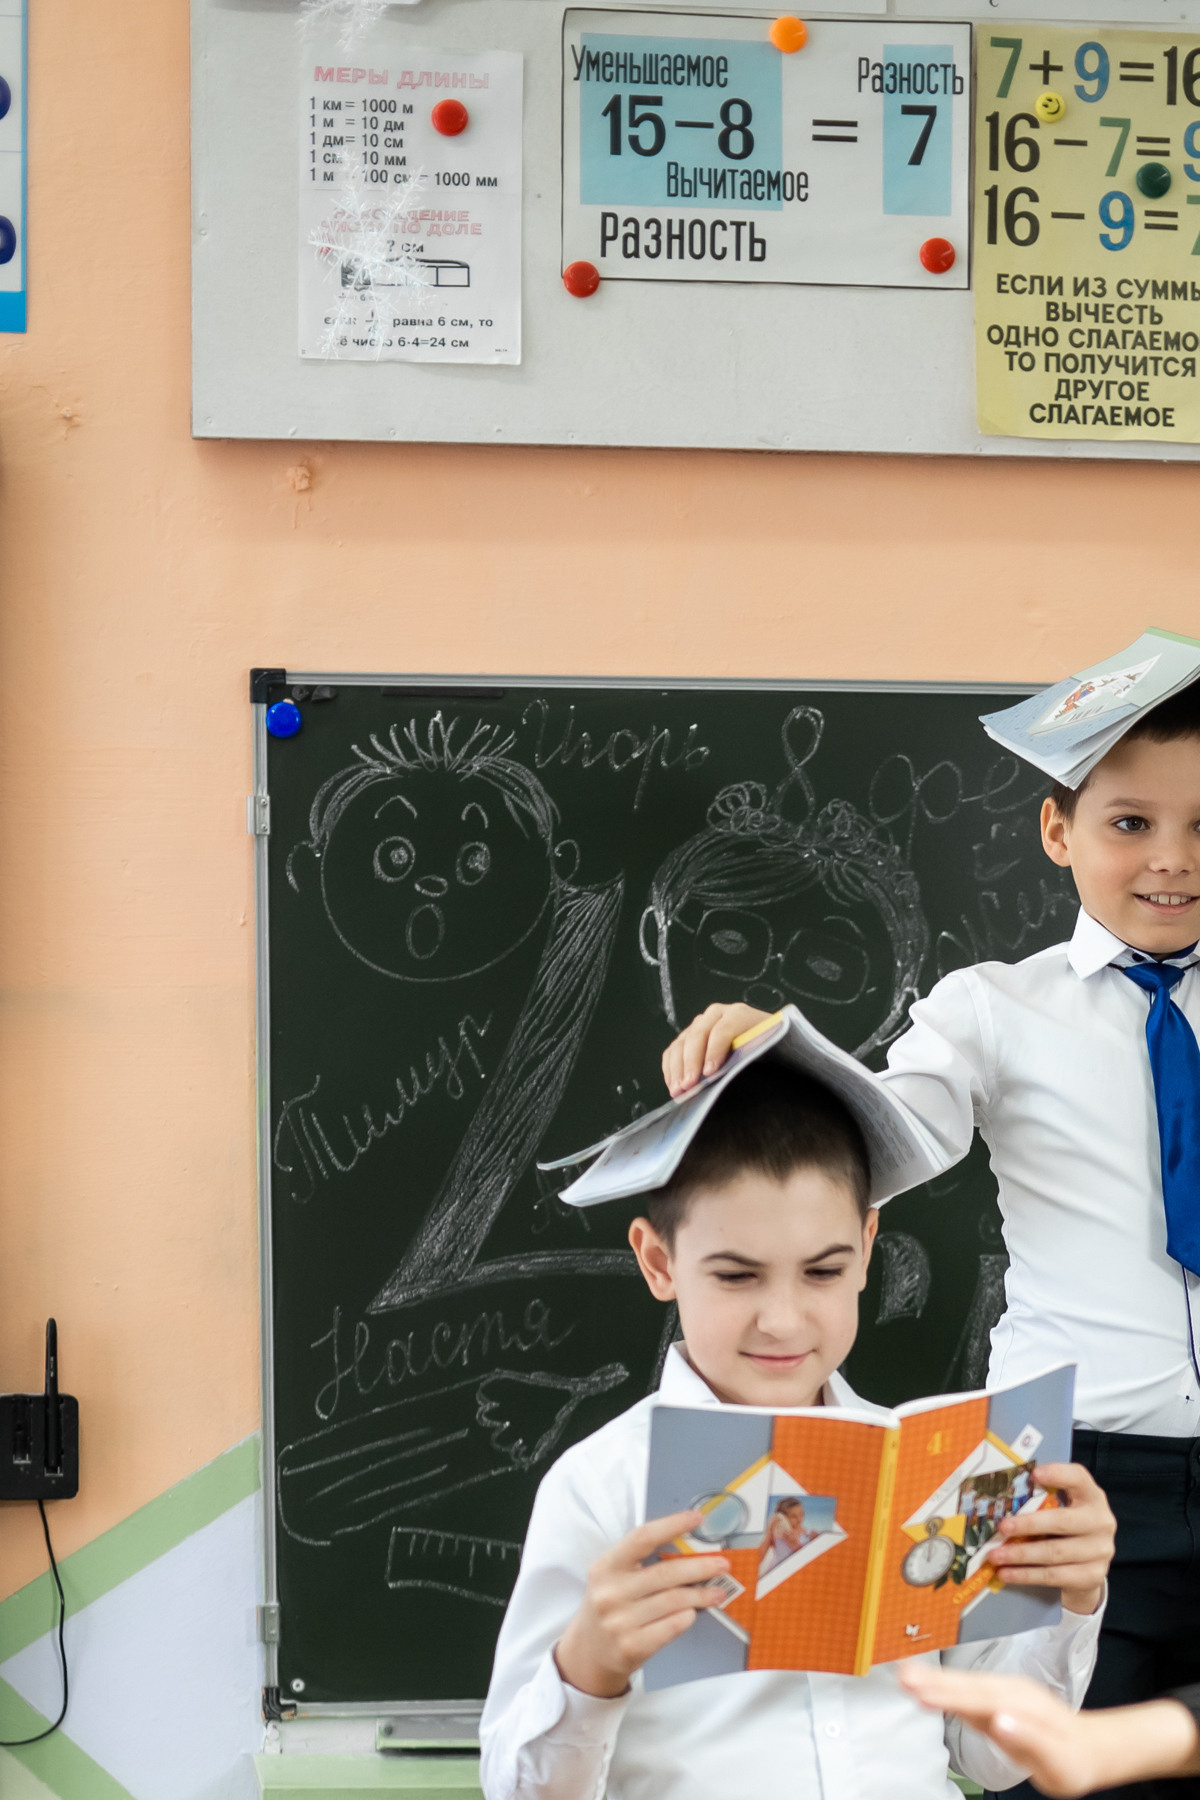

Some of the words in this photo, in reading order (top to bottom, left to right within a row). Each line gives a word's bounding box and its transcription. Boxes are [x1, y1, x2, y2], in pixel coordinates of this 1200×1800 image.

[314, 65, 389, 85] МЕРЫ
[396, 70, 489, 90] ДЛИНЫ
[570, 44, 729, 88] Уменьшаемое
[857, 57, 964, 96] Разность
[362, 99, 397, 114] 1000
[402, 104, 413, 114] м
[323, 118, 334, 128] м
[362, 117, 379, 130] 10
[383, 120, 404, 133] дм
[900, 104, 937, 166] 7
[362, 134, 379, 148] 10
[384, 137, 404, 149] см
[362, 151, 379, 165] 10
[384, 155, 407, 166] мм
[323, 171, 334, 181] м
[435, 172, 470, 187] 1000
[476, 176, 498, 187] мм
[667, 161, 809, 202] Вычитаемое
[393, 222, 421, 234] ПО
[427, 223, 482, 237] ДОЛЕ
[600, 211, 767, 262] Разность
[996, 273, 1063, 297] ЕСЛИ
[1072, 277, 1107, 298] ИЗ
[393, 316, 433, 328] равна
[437, 316, 446, 326] 6
[479, 318, 494, 327] то
[1045, 303, 1163, 325] ВЫЧЕСТЬ
[353, 337, 393, 348] чисо
[451, 339, 469, 348] см
[987, 325, 1059, 348] ОДНО
[1005, 351, 1036, 372] ТО
[1044, 353, 1196, 377] ПОЛУЧИТСЯ
[1054, 378, 1149, 402] ДРУГОЕ
[1029, 404, 1175, 428] СЛАГАЕМОЕ
